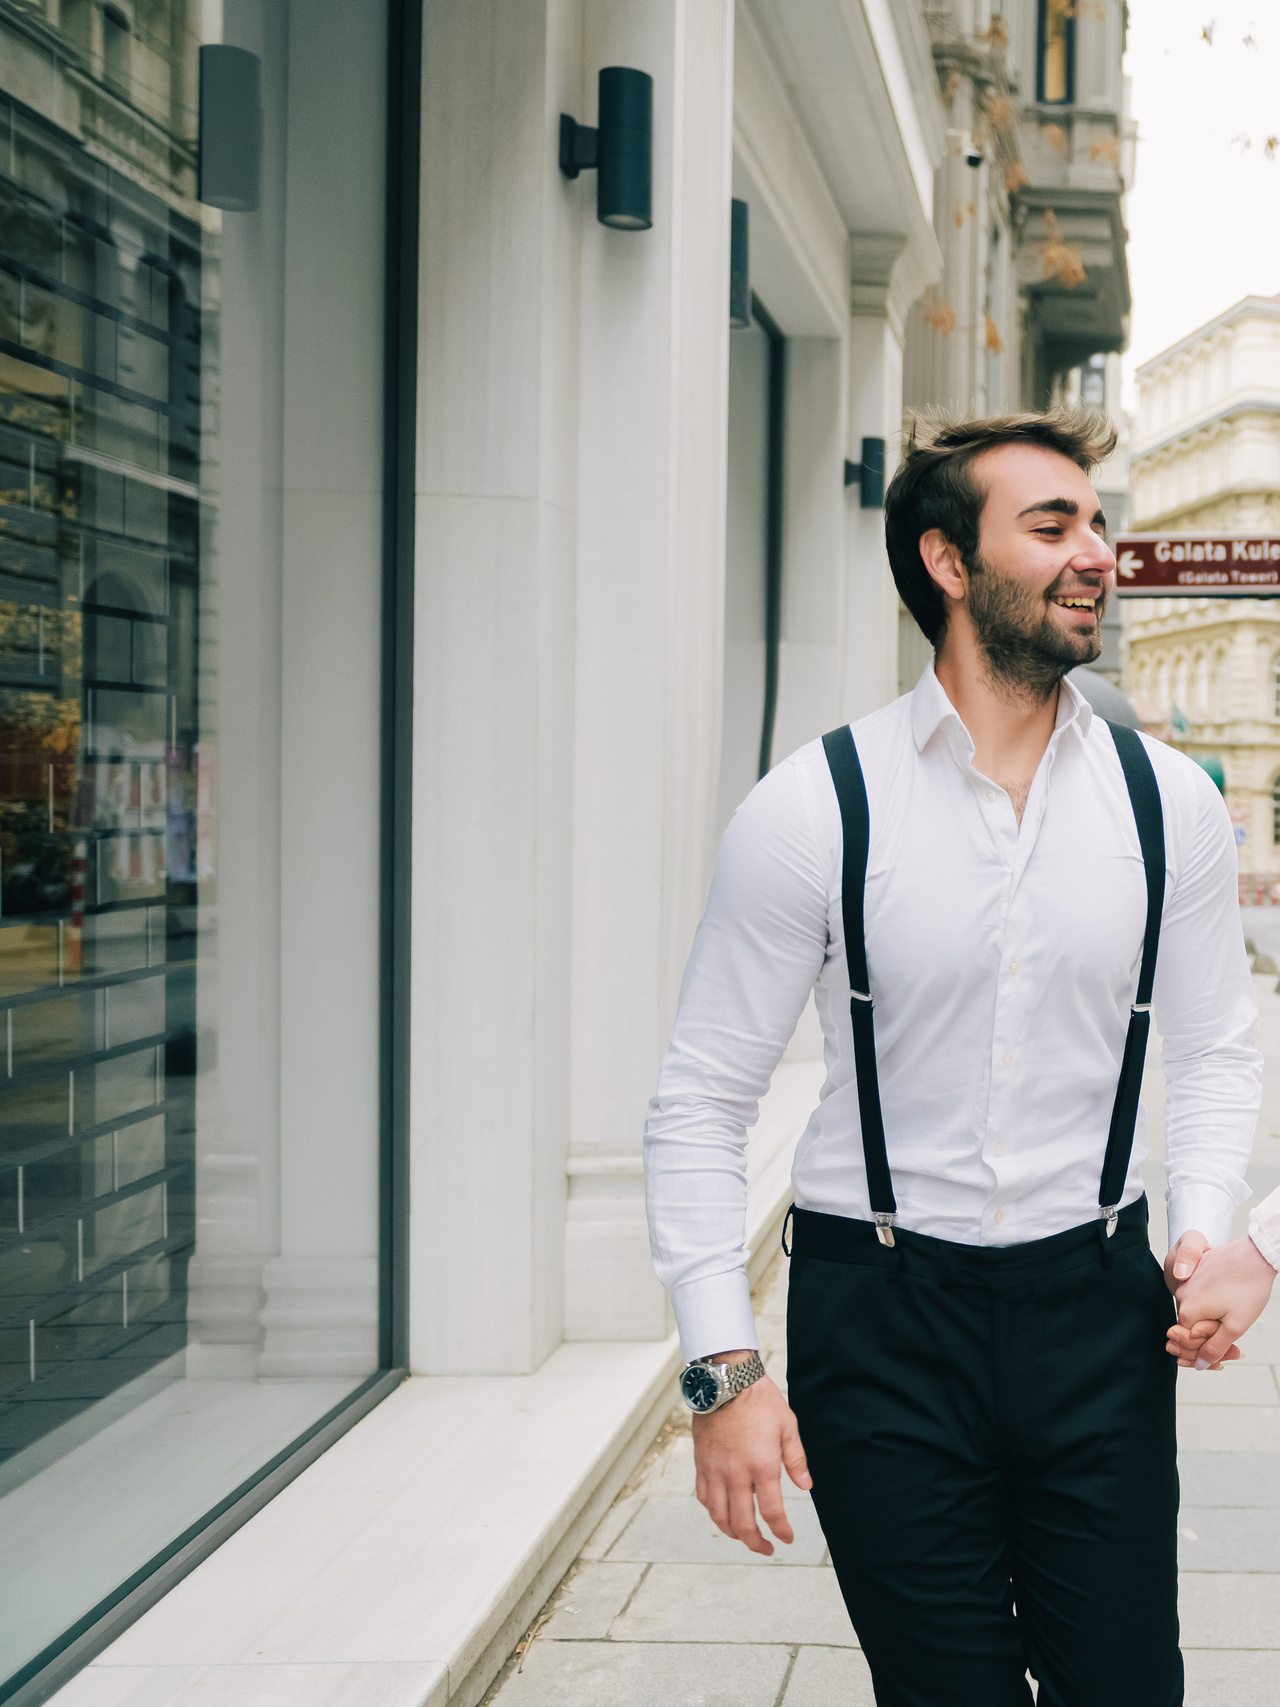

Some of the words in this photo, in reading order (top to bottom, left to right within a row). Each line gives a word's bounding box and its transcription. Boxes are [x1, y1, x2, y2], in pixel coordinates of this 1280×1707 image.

[1154, 541, 1227, 562] Galata
[1178, 570, 1229, 584] (Galata
[1230, 569, 1279, 584] Tower)
